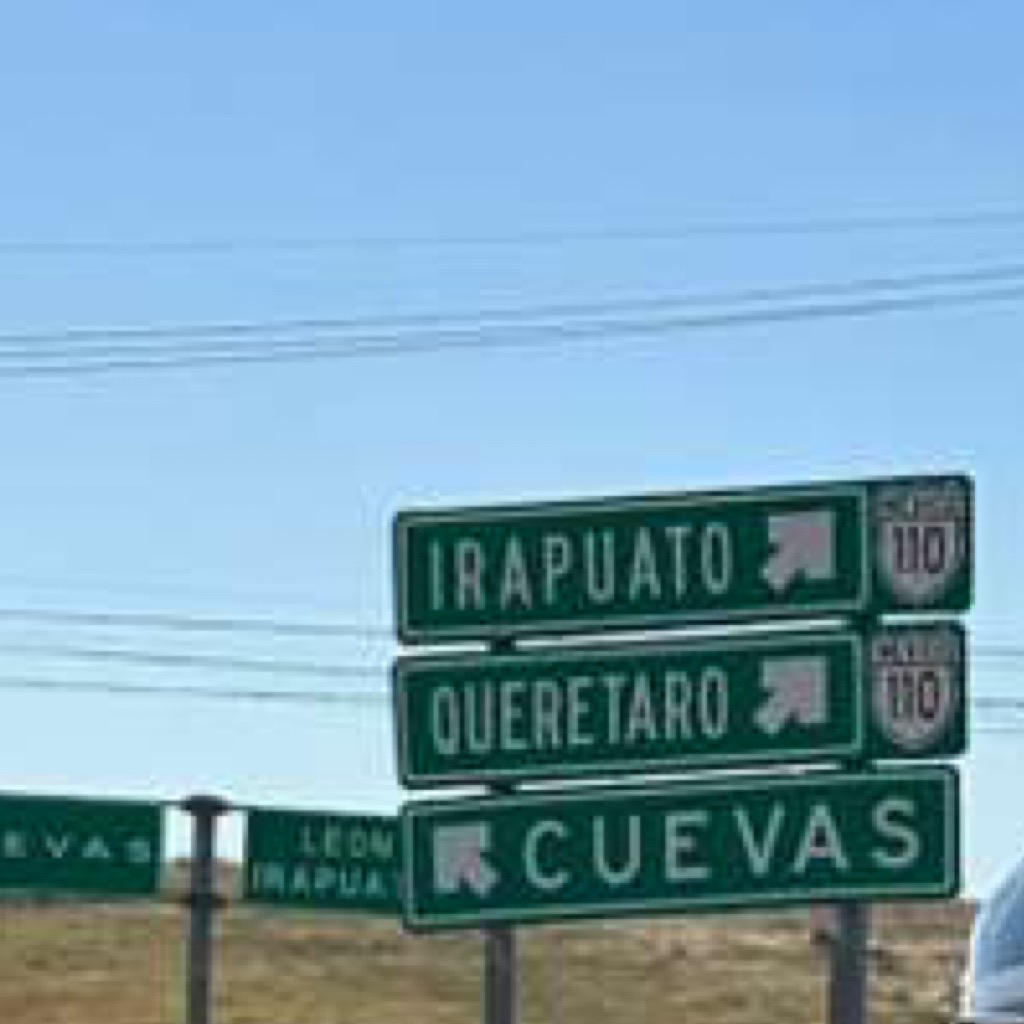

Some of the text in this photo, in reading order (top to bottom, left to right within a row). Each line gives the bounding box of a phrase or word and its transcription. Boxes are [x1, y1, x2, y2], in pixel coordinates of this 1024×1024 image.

[430, 524, 947, 611] IRAPUATO 110
[432, 667, 938, 756] QUERETARO 110
[252, 863, 400, 899] IRAPUA
[523, 798, 920, 892] CUEVAS
